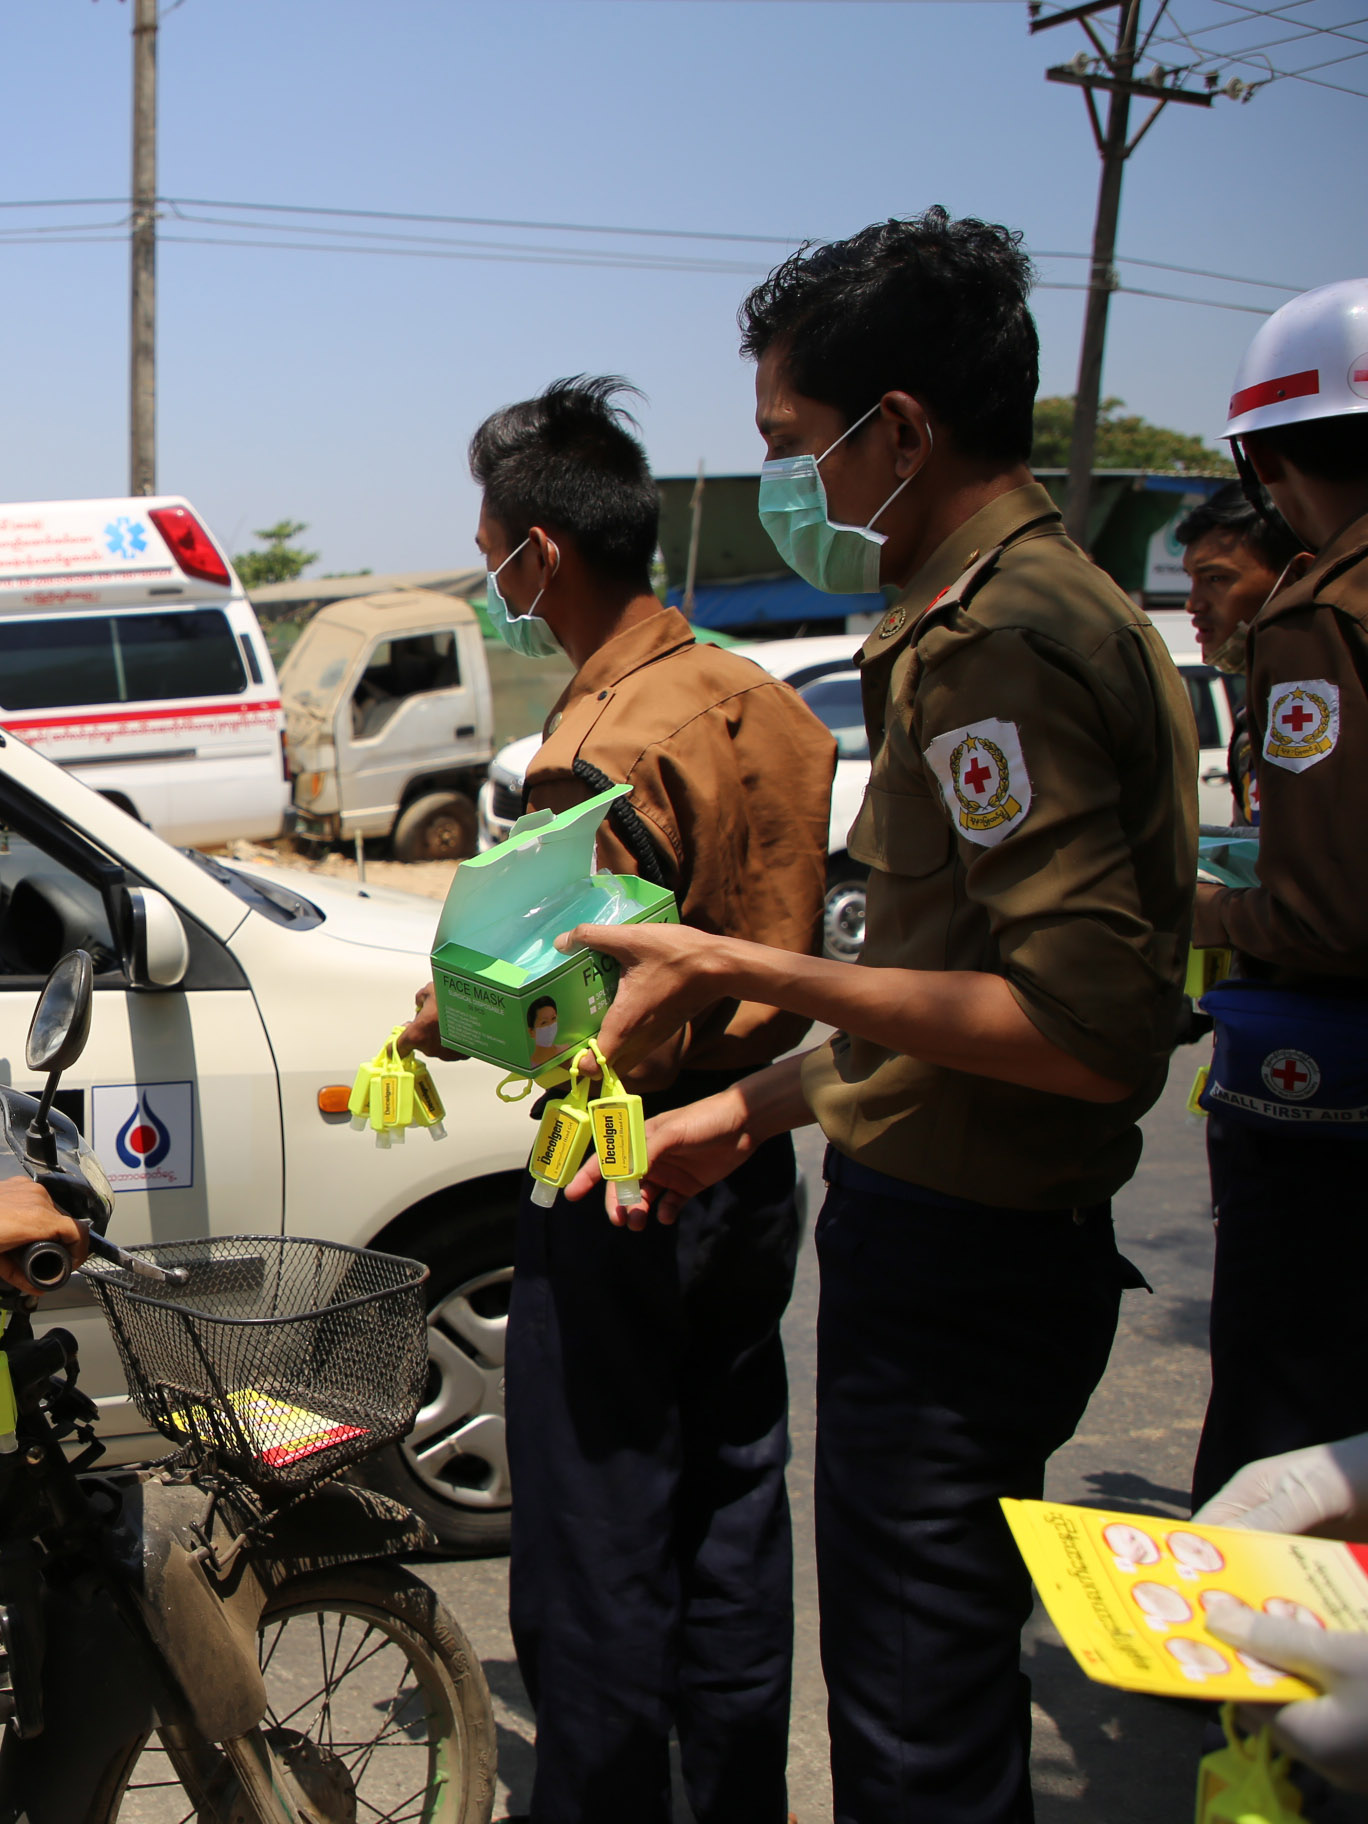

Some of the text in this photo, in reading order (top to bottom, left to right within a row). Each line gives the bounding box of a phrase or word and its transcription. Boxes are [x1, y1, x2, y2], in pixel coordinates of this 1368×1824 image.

[443, 975, 506, 1009] FACE MASK
[1212, 1086, 1259, 1110] SMALL
[1263, 1103, 1313, 1119] FIRST
[1320, 1111, 1353, 1120] AID
[540, 1120, 564, 1165] Decolgen
[604, 1116, 617, 1165] Decolgen
